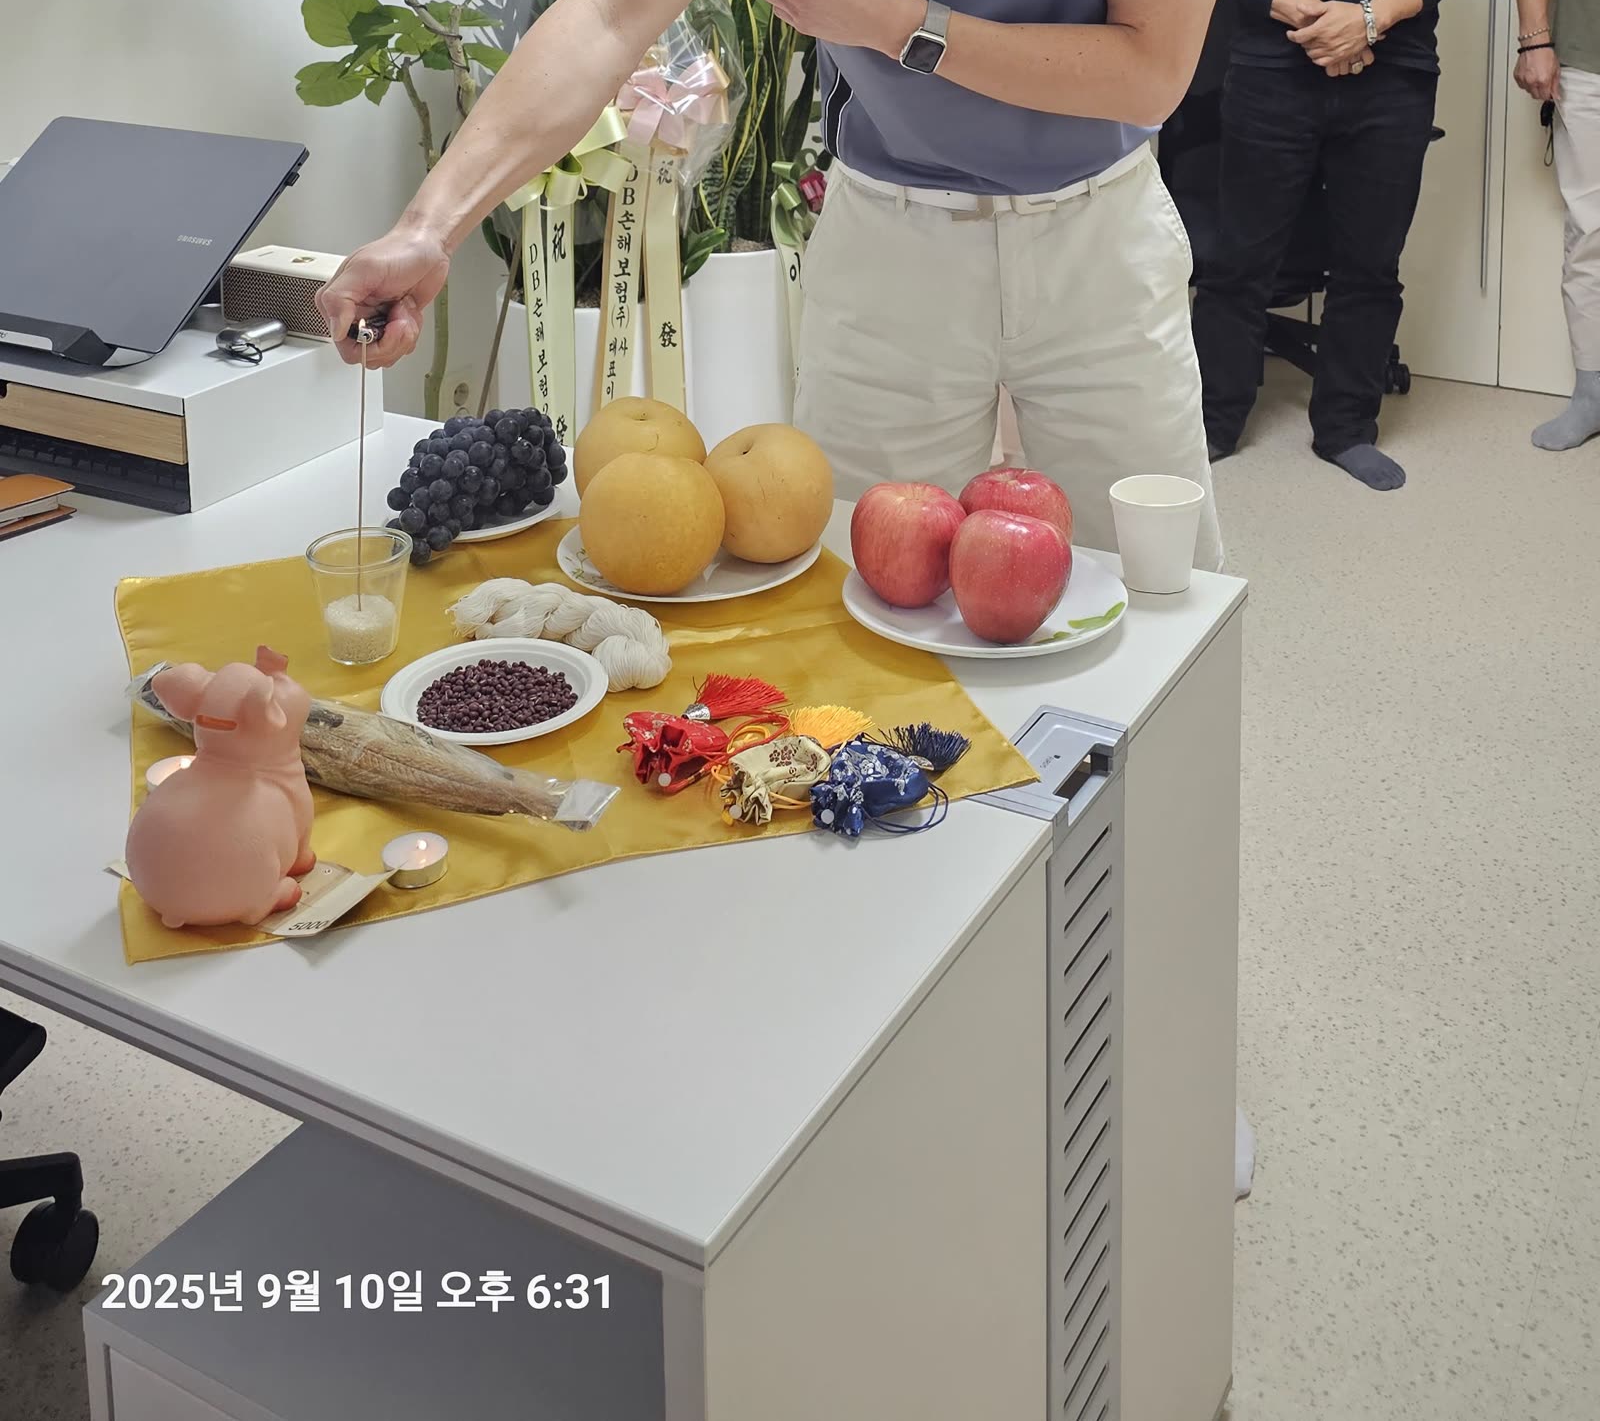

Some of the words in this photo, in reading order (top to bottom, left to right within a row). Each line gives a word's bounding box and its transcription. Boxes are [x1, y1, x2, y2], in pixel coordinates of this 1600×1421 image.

[551, 219, 567, 264] 祝
[528, 242, 549, 415] DB손해보험
[658, 321, 678, 349] 發
